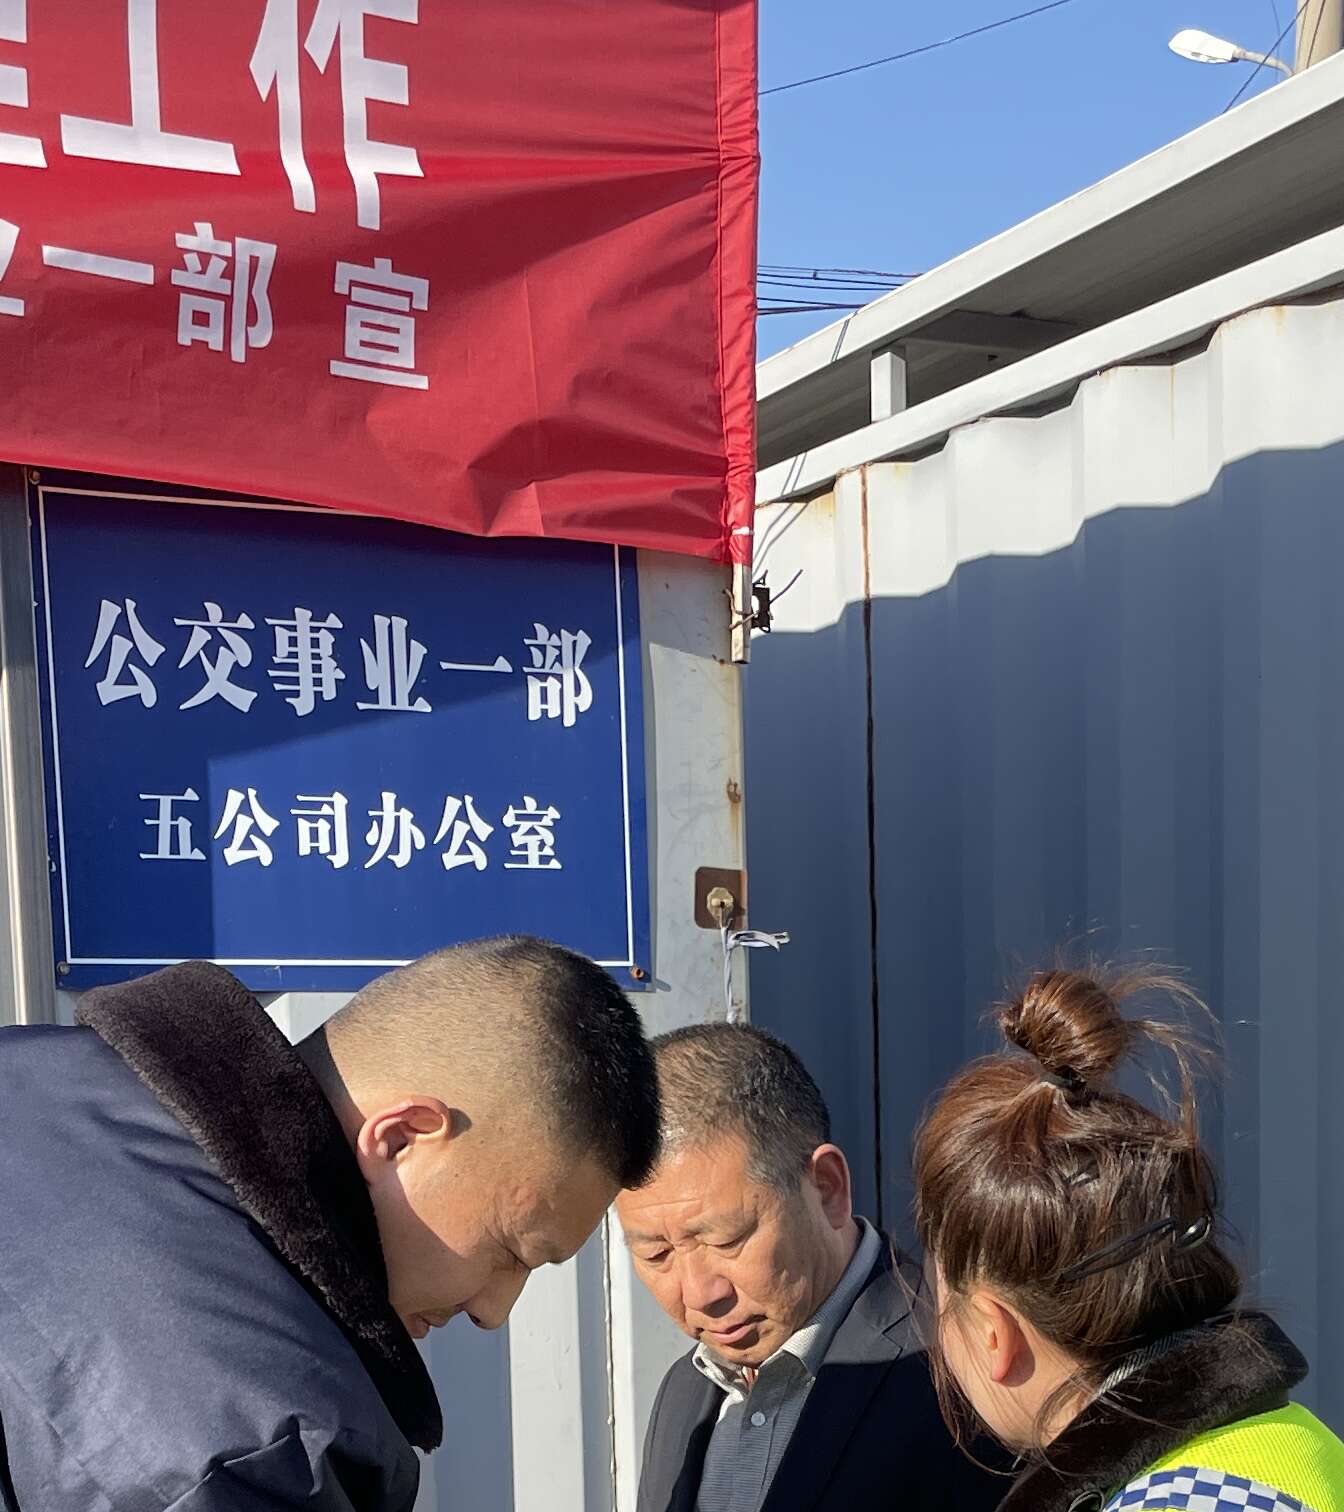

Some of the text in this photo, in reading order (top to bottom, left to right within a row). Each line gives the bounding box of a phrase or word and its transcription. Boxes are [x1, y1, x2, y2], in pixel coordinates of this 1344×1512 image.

[328, 257, 430, 391] 宣
[84, 598, 594, 728] 公交事业一部
[138, 787, 564, 872] 五公司办公室
